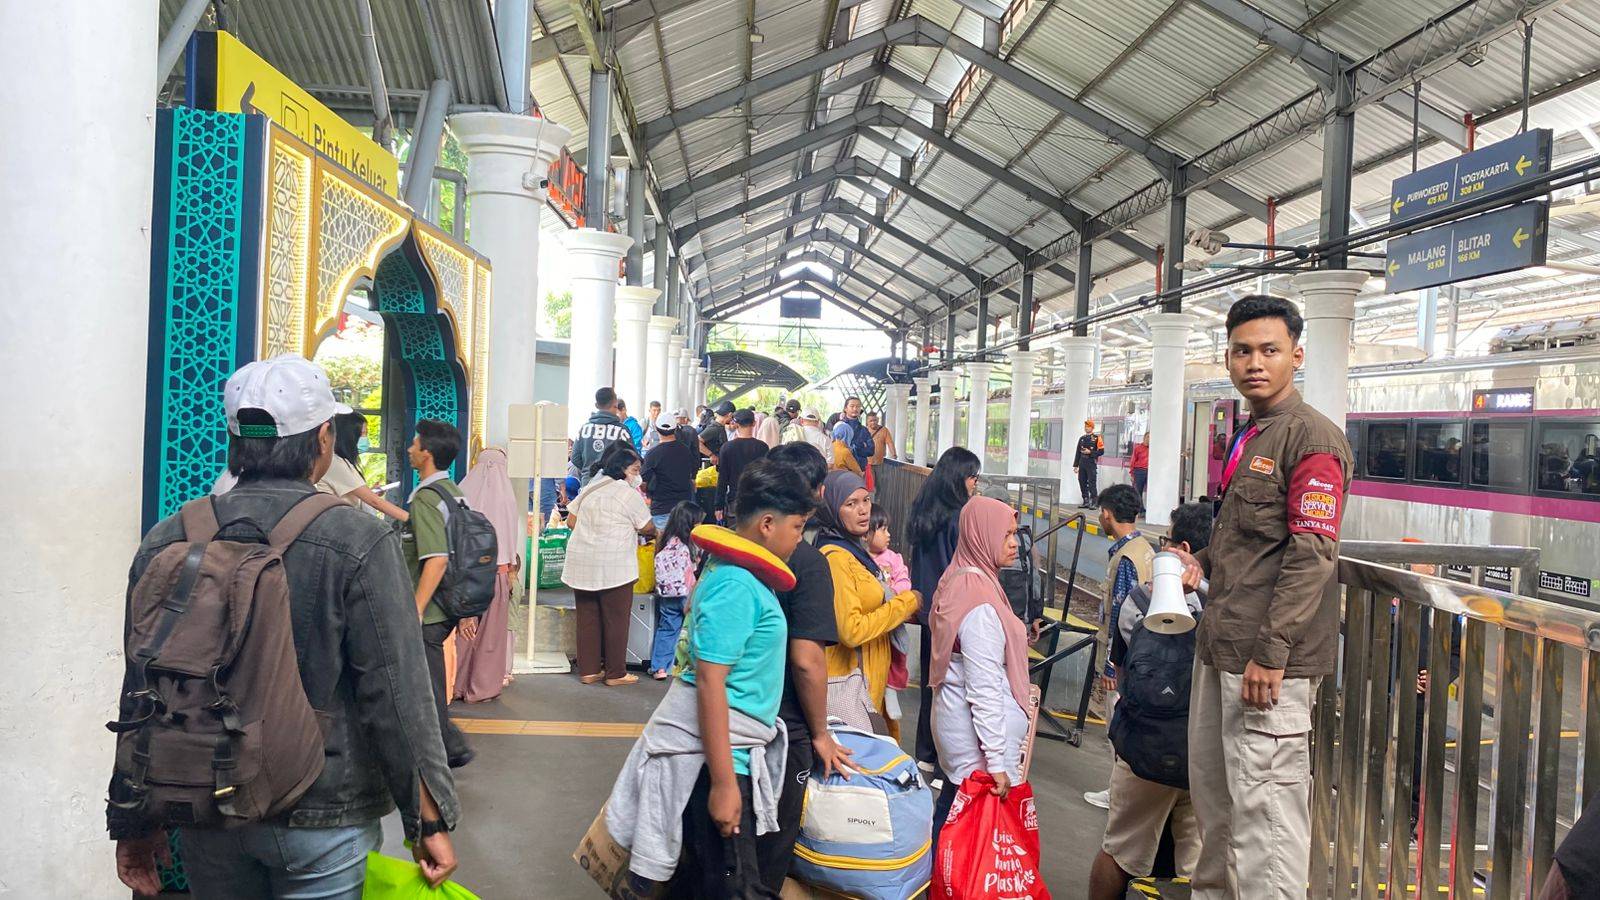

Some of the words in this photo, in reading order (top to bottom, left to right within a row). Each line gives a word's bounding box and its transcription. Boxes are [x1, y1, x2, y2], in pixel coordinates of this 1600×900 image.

[314, 123, 347, 167] Pintu
[351, 148, 387, 191] Keluar
[1460, 161, 1509, 184] YOGYAKARTA
[1406, 181, 1449, 203] PURWOKERTO
[1471, 181, 1484, 192] KM
[1437, 193, 1448, 203] KM
[1457, 233, 1491, 252] BLITAR
[1407, 245, 1446, 265] MALANG
[1468, 250, 1481, 261] KM
[1435, 258, 1446, 269] KM
[1295, 520, 1320, 528] TANYA
